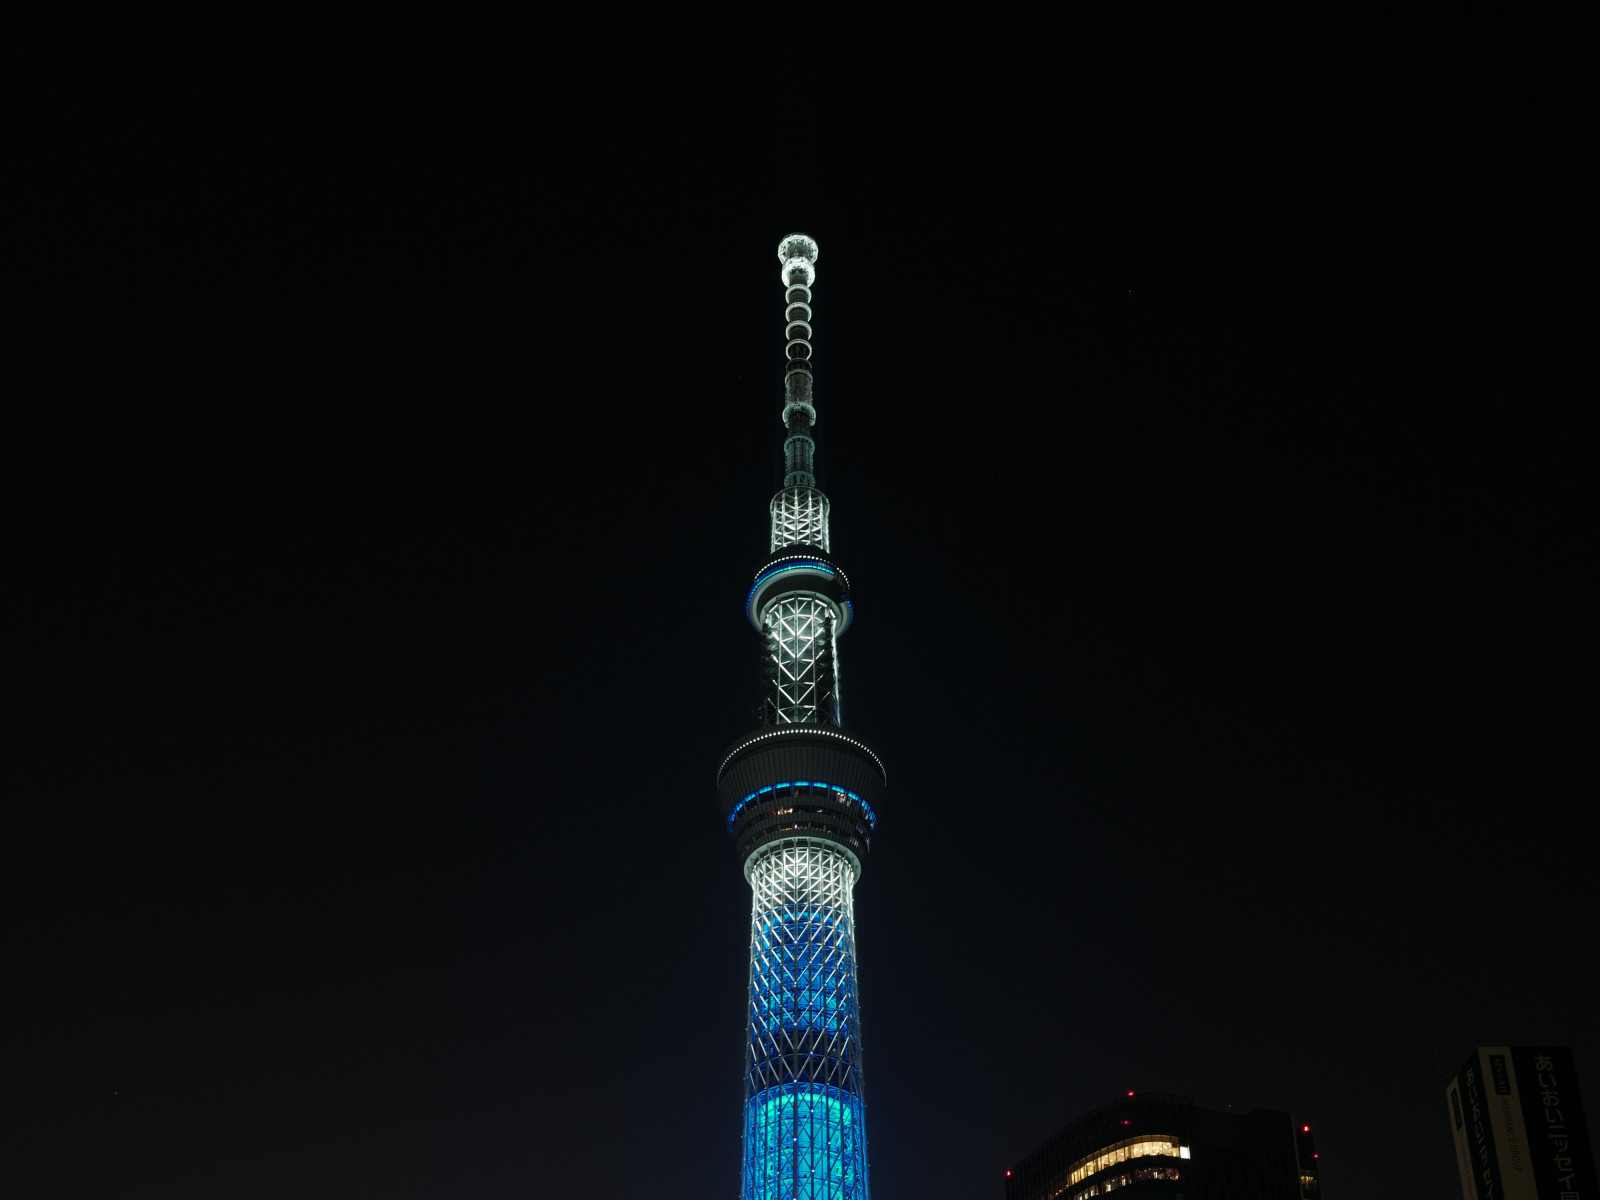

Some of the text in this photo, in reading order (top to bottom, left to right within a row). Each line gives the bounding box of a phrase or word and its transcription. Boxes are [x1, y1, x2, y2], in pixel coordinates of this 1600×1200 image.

[1491, 1056, 1509, 1094] MS&AD
[1500, 1096, 1522, 1173] INSURANCE GROUP
